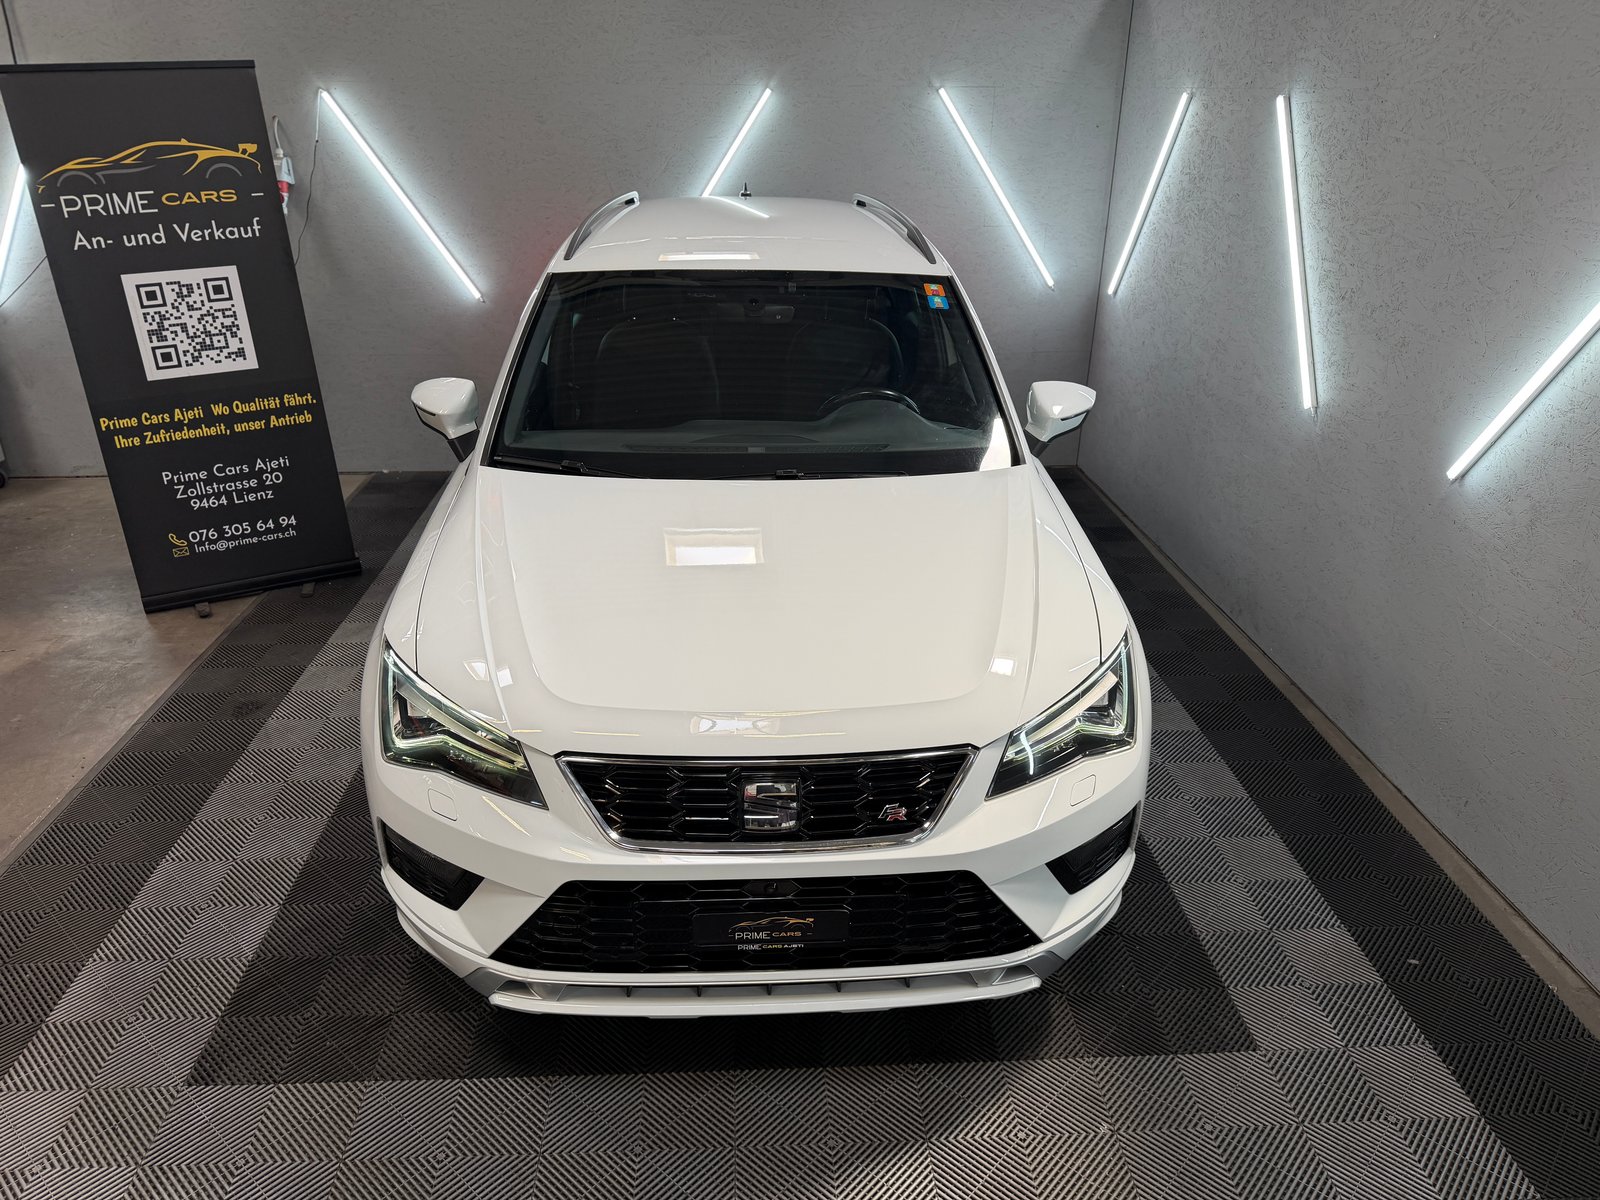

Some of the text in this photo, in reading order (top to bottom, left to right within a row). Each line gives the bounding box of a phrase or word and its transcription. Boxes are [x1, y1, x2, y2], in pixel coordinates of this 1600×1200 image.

[59, 189, 238, 218] PRIME CARS
[73, 217, 262, 251] An- und Verkauf
[99, 392, 317, 432] Prime Cars Ajeti Wo Qualität fährt.
[114, 410, 313, 449] Ihre Zufriedenheit, unser Antrieb
[161, 455, 290, 485] Prime Cars Ajeti
[173, 471, 283, 499] Zollstrasse 20
[190, 489, 274, 511] 9464 Lienz
[188, 515, 297, 543] 076 305 64 94
[194, 527, 297, 553] Info@prime-cars.ch
[735, 931, 771, 940] PRIME
